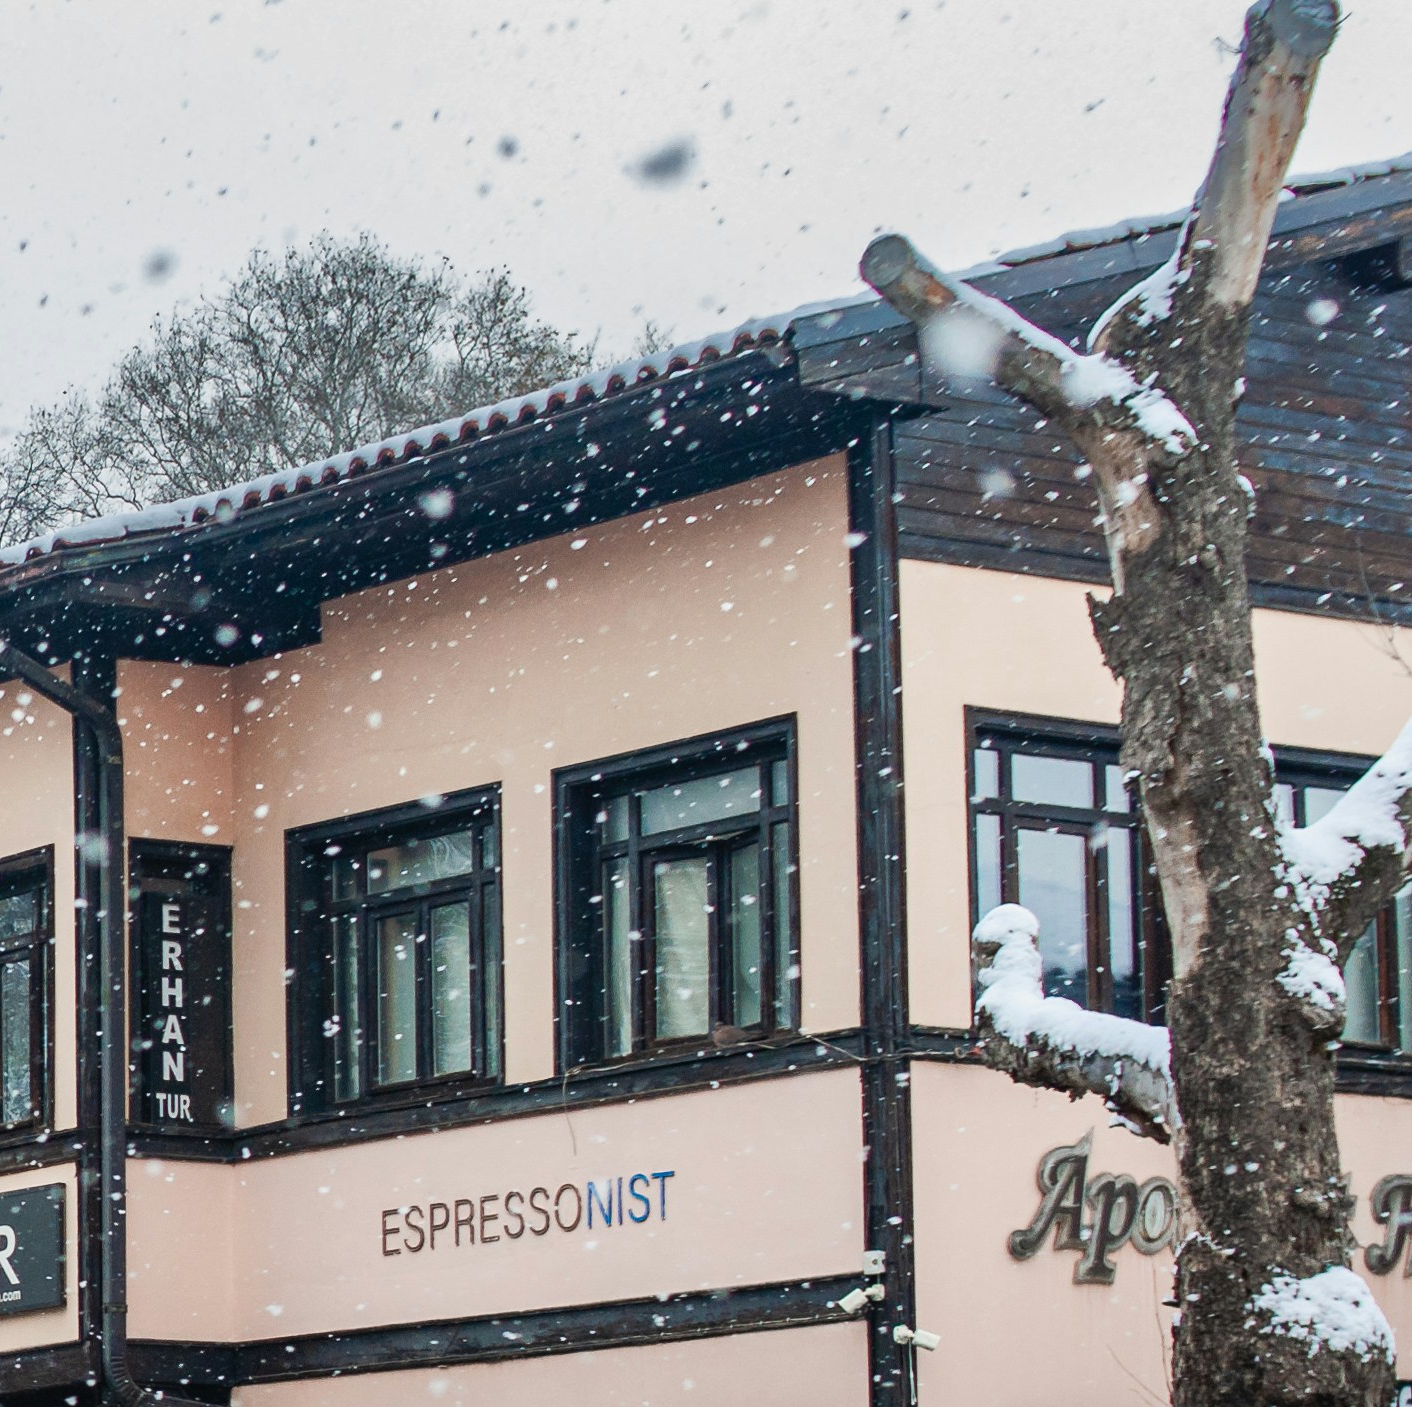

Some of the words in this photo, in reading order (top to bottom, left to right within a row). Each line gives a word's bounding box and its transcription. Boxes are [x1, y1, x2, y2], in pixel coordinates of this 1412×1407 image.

[161, 904, 184, 1082] ERHAN
[156, 1093, 192, 1120] TUR
[381, 1171, 675, 1257] ESPRESSONIST
